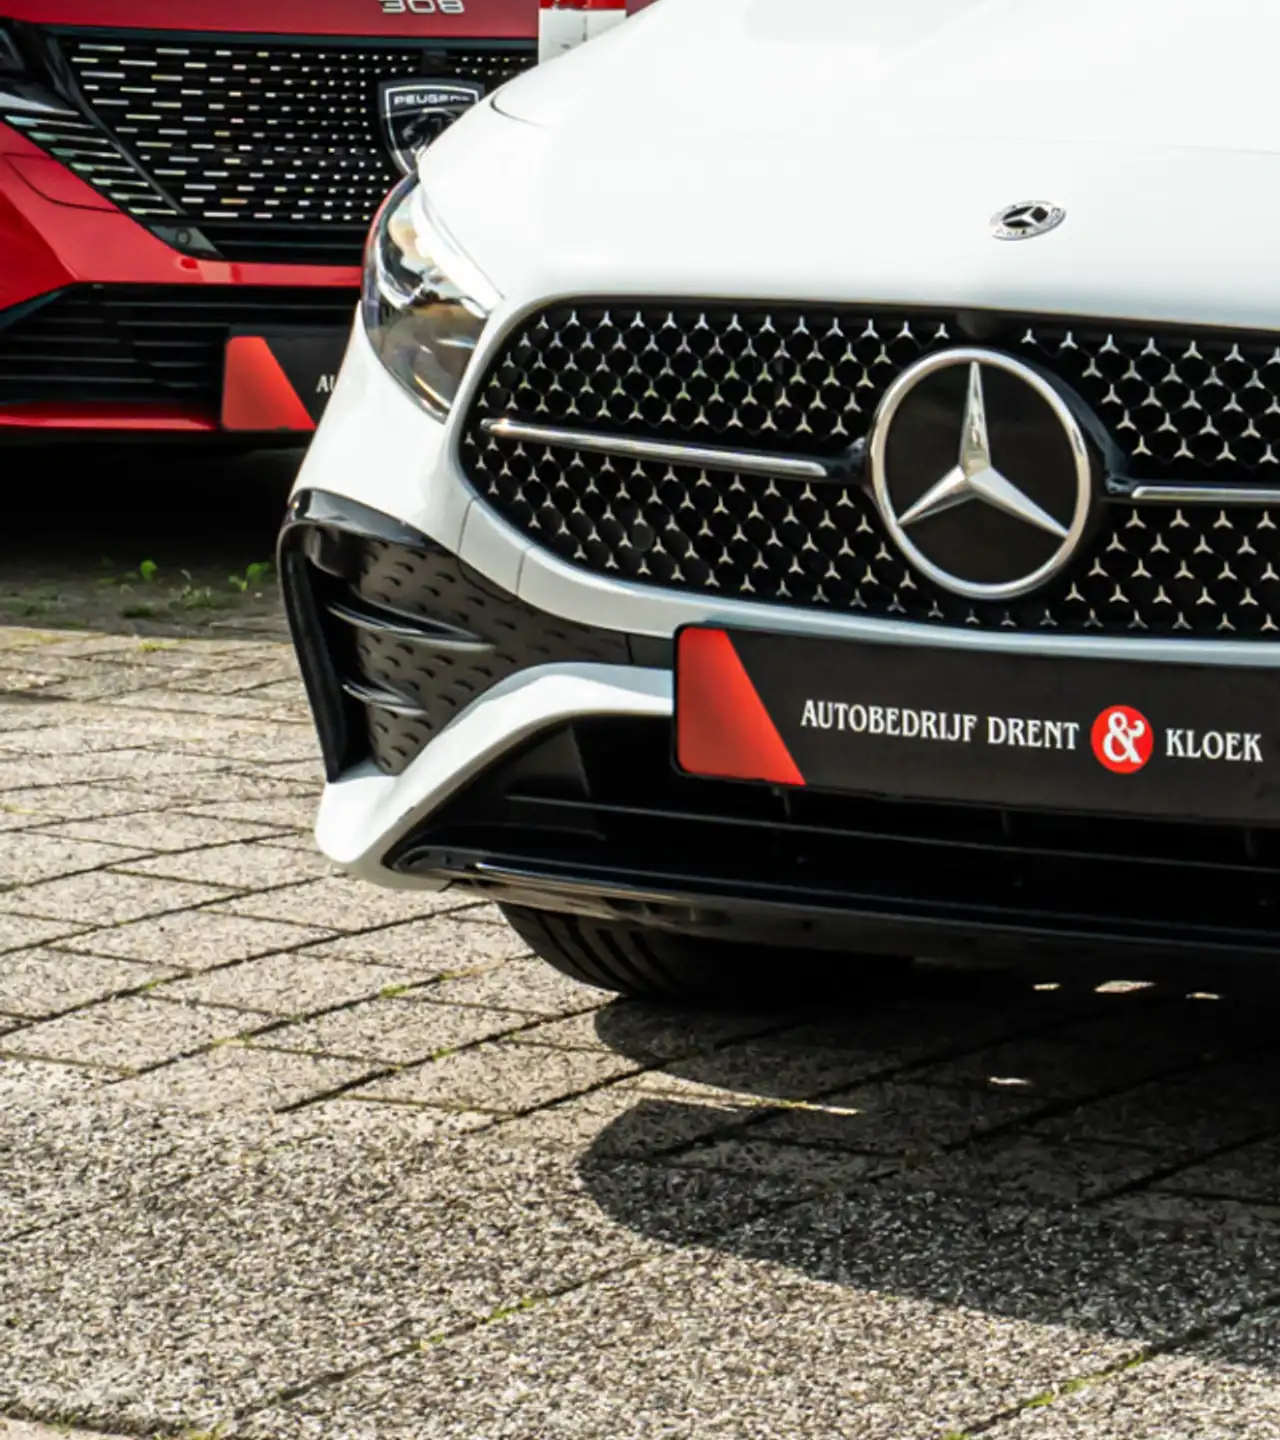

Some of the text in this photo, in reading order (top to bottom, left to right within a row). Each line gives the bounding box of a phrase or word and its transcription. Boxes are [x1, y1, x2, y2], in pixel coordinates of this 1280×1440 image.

[800, 699, 1264, 764] AUTOBEDRIJF DRENT & KLOEK
